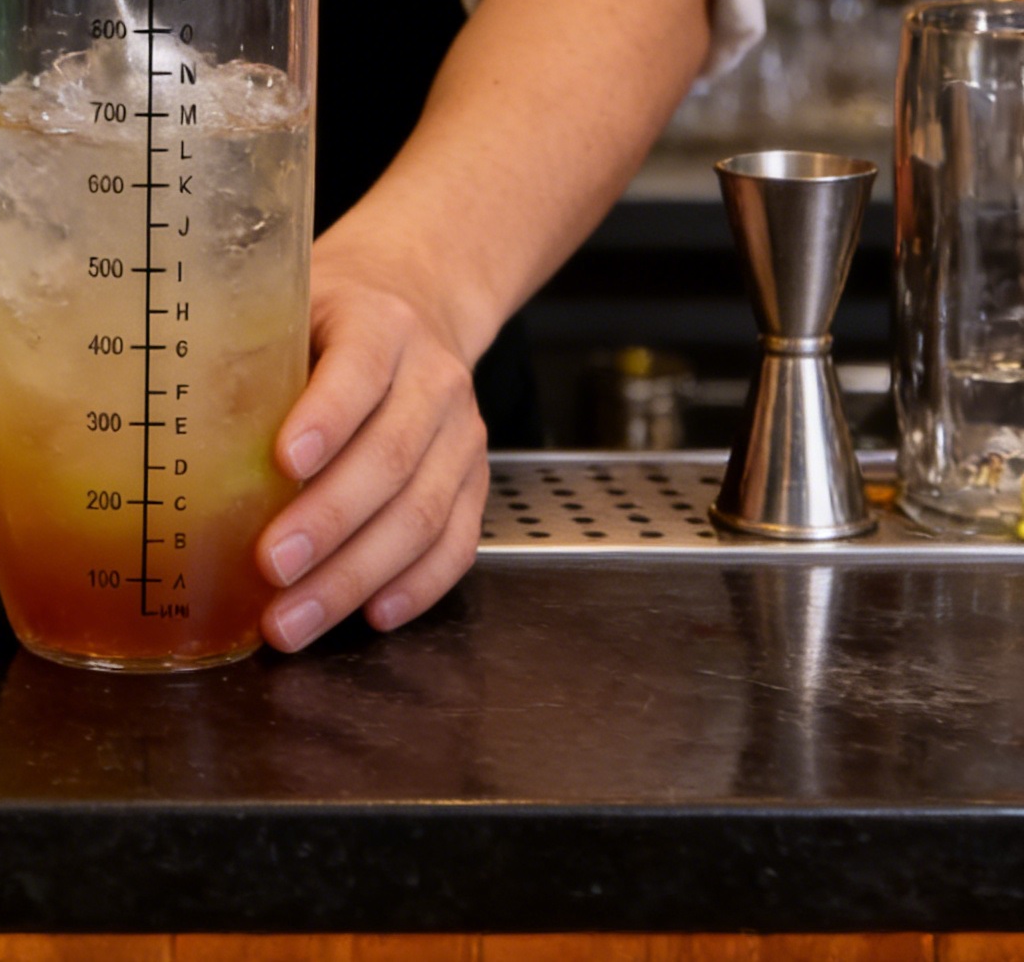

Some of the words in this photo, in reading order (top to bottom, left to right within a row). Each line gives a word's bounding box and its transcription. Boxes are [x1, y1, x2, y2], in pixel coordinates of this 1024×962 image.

[180, 63, 197, 85] N
[91, 102, 127, 122] 700
[180, 103, 197, 125] M
[180, 140, 193, 160] L
[88, 174, 124, 194] 600
[179, 175, 193, 195] K
[178, 216, 190, 236] J
[88, 256, 124, 278] 500
[176, 302, 189, 321] H
[88, 335, 124, 355] 400
[176, 384, 189, 401] F
[86, 412, 122, 432] 300
[175, 417, 188, 435] E
[174, 459, 187, 476] D
[86, 491, 122, 510] 200
[174, 496, 187, 512] C
[174, 533, 187, 549] B
[88, 569, 121, 589] 100
